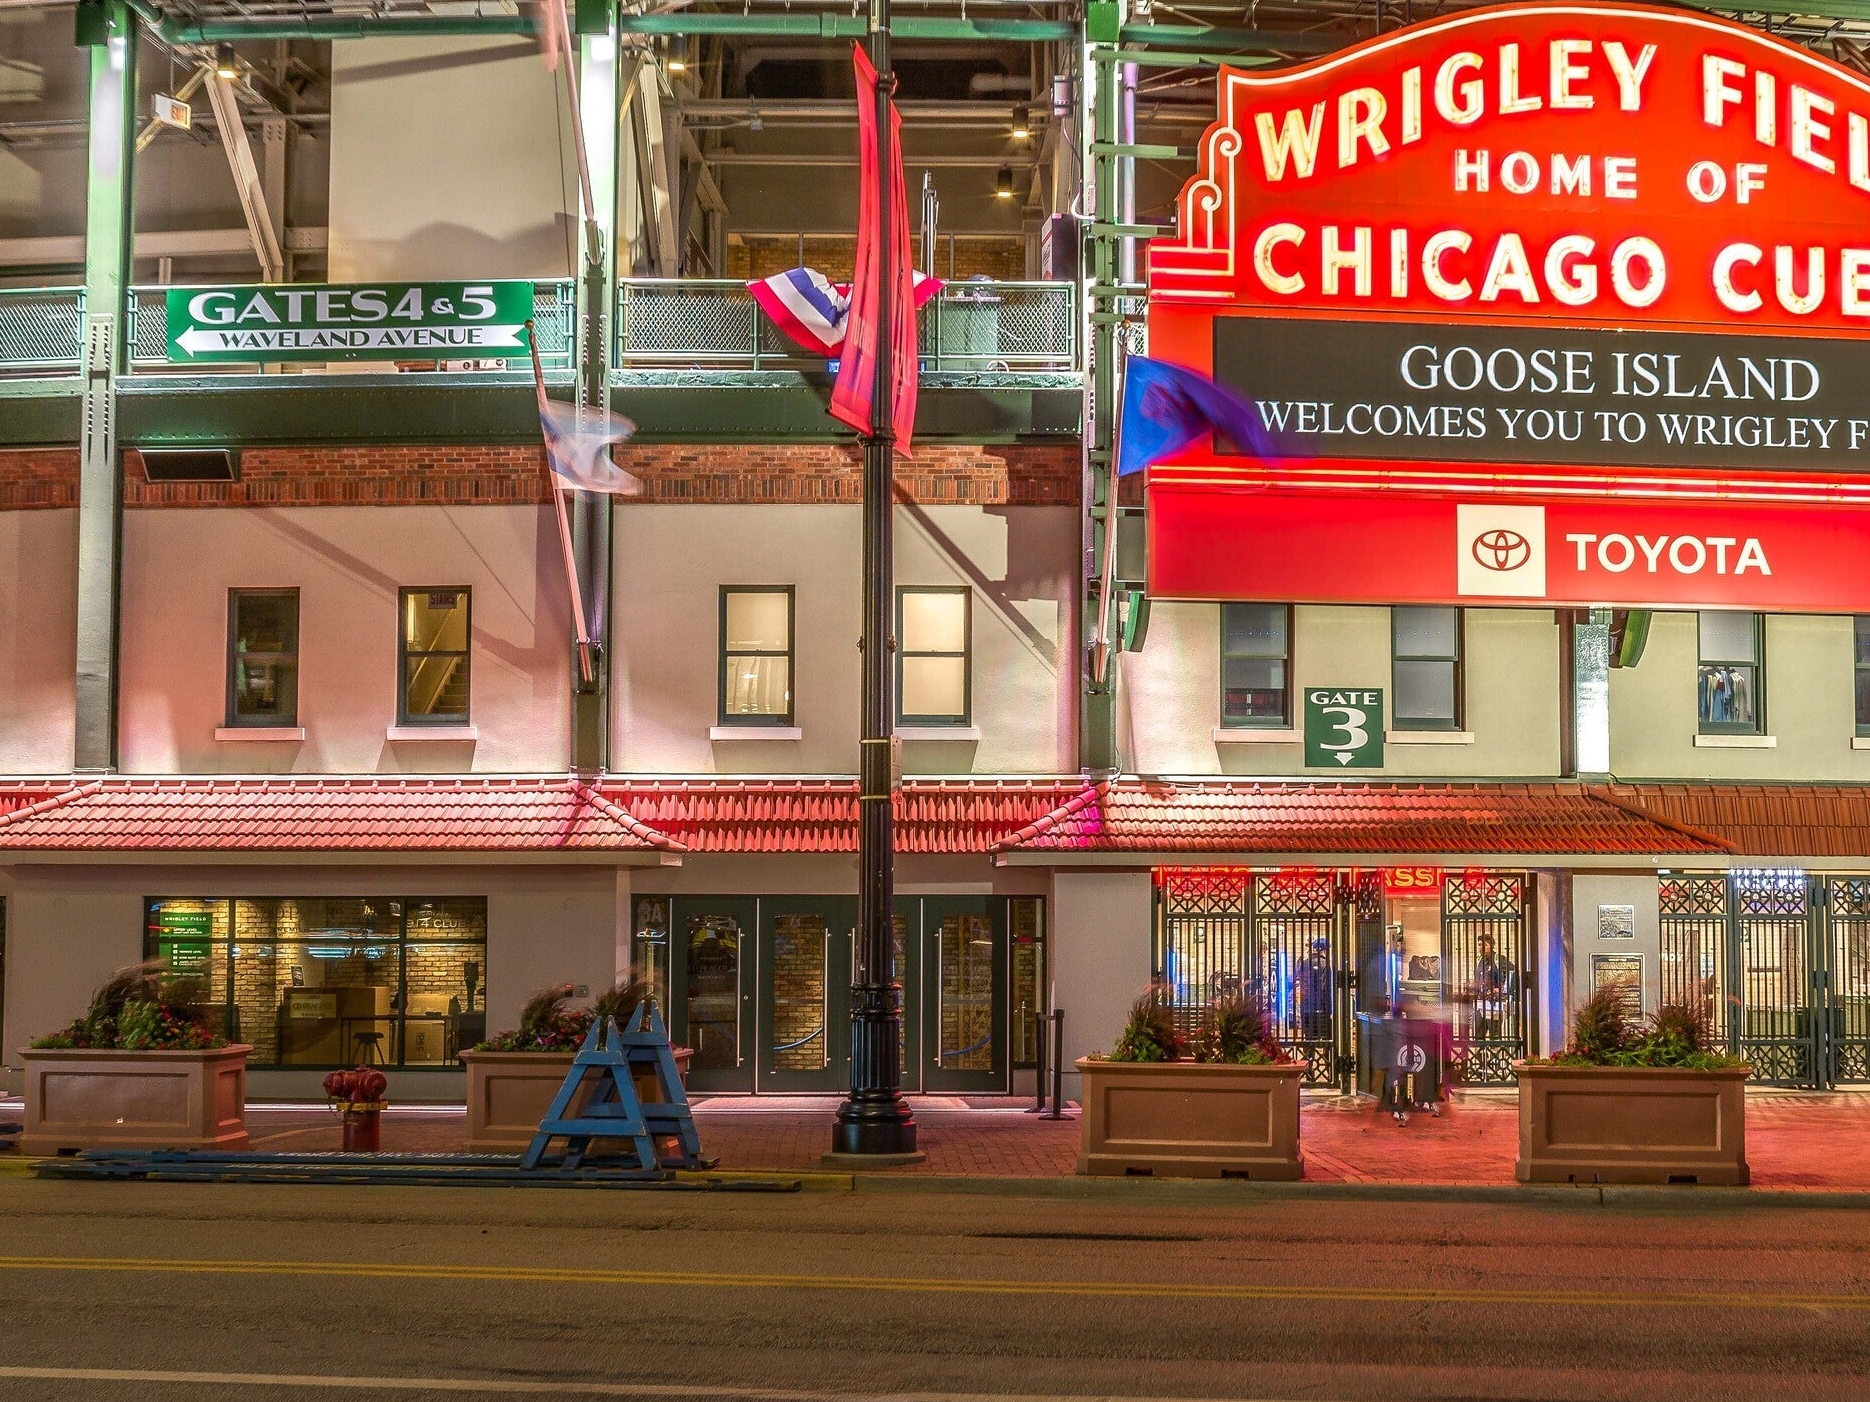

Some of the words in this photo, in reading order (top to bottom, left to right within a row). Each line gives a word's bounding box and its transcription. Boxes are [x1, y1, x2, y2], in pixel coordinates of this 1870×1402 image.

[1254, 38, 1658, 182] WRIGLEY
[1455, 148, 1637, 198] HOME
[1685, 160, 1770, 205] OF
[1253, 222, 1668, 308] CHICAGO
[188, 289, 389, 325] GATES
[219, 329, 370, 348] WAVELAND
[377, 327, 483, 346] AVENUE
[1399, 344, 1596, 397] GOOSE
[1611, 350, 1820, 403] ISLAND
[1256, 400, 1486, 442] WELCOMES
[1497, 409, 1586, 445] YOU
[1594, 413, 1647, 447] TO
[1657, 416, 1837, 451] WRIGLEY
[1566, 534, 1772, 577] TOYOTA
[1310, 691, 1378, 705] GATE
[1320, 706, 1369, 750] 3
